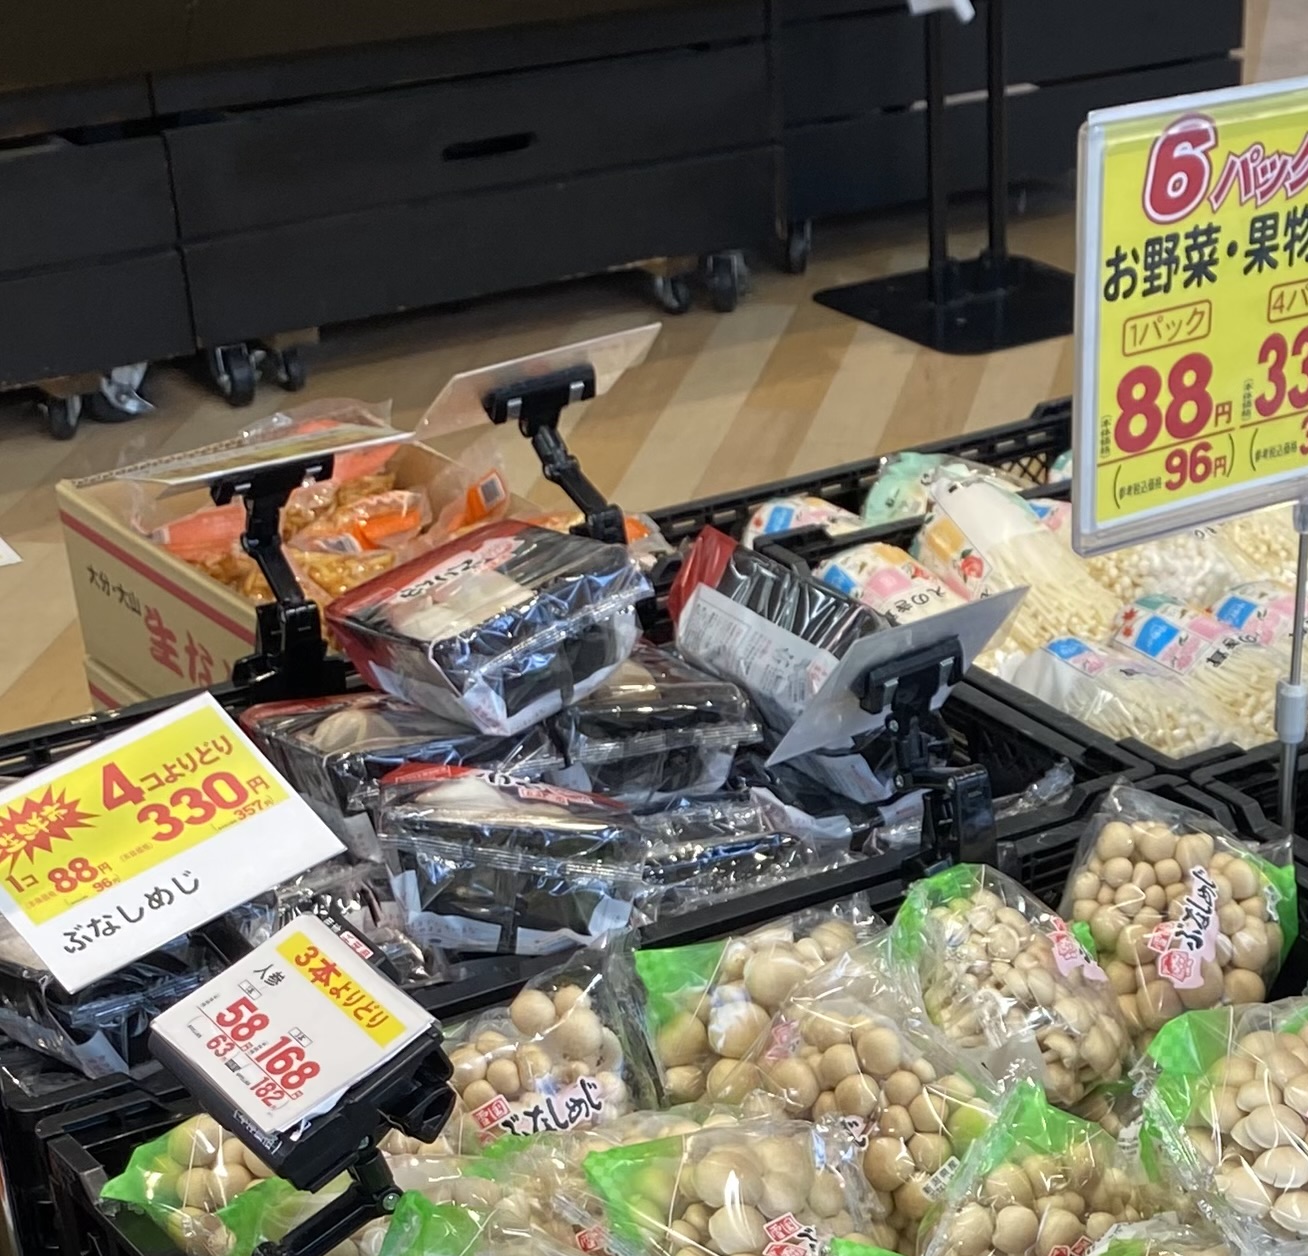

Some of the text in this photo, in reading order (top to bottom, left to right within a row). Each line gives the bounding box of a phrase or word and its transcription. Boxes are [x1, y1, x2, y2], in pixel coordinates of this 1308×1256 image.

[1131, 309, 1205, 345] 1パック
[137, 771, 270, 842] 330円
[63, 870, 200, 954] ぶなしめじ
[1174, 867, 1219, 952] ぶなしめじ
[294, 945, 390, 1030] 3本よりどり
